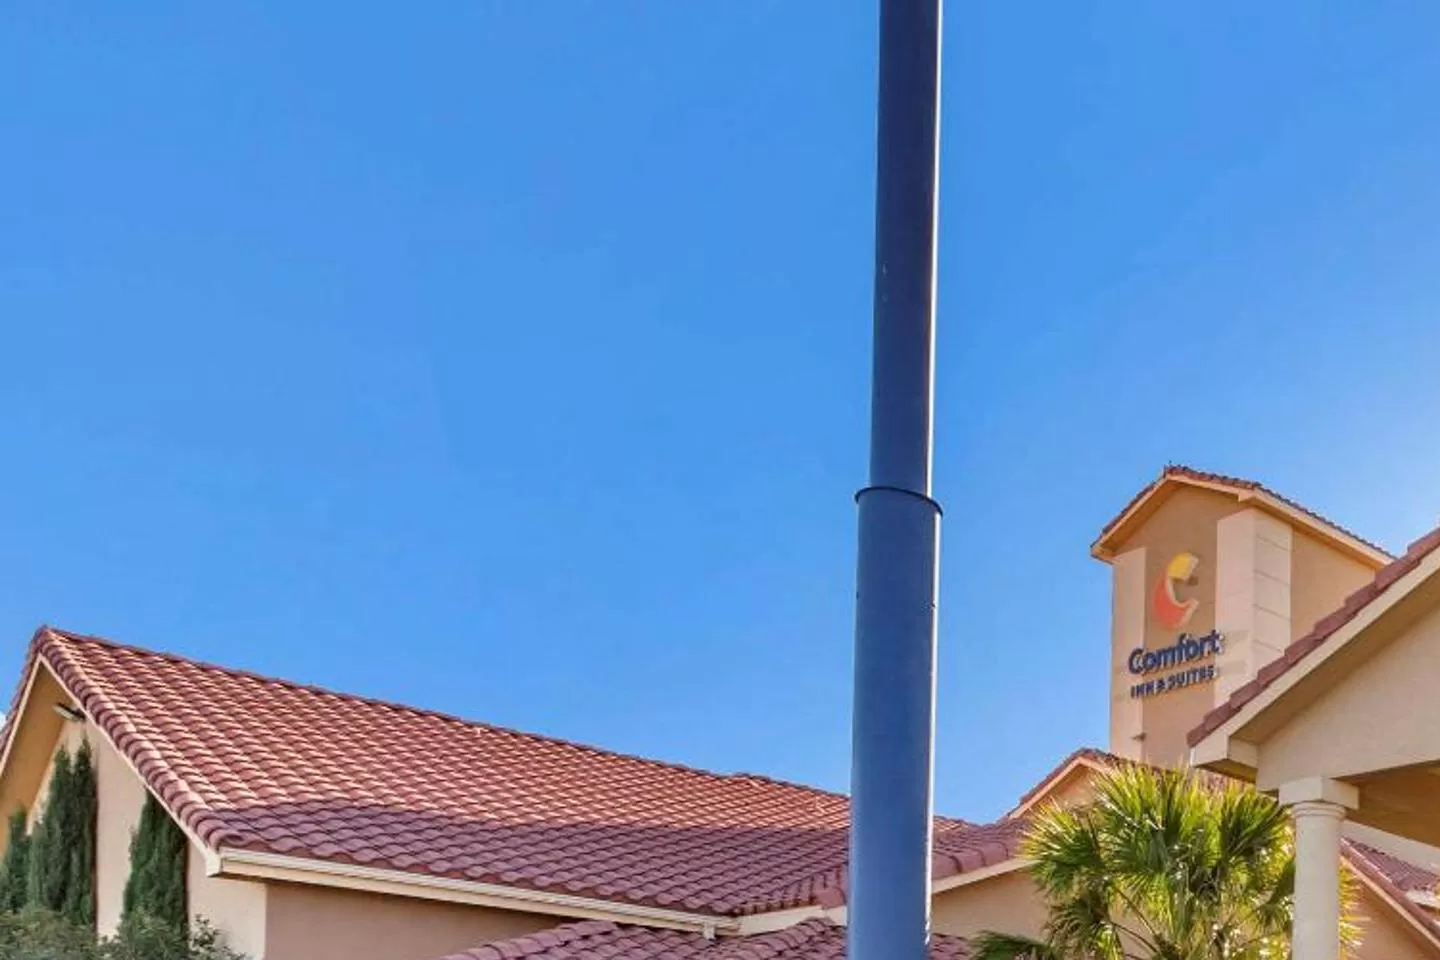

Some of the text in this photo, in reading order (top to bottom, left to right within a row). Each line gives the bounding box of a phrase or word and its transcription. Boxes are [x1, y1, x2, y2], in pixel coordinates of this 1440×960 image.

[1128, 629, 1224, 675] Comfort
[1130, 680, 1156, 699] INN
[1167, 664, 1216, 691] SUITES
